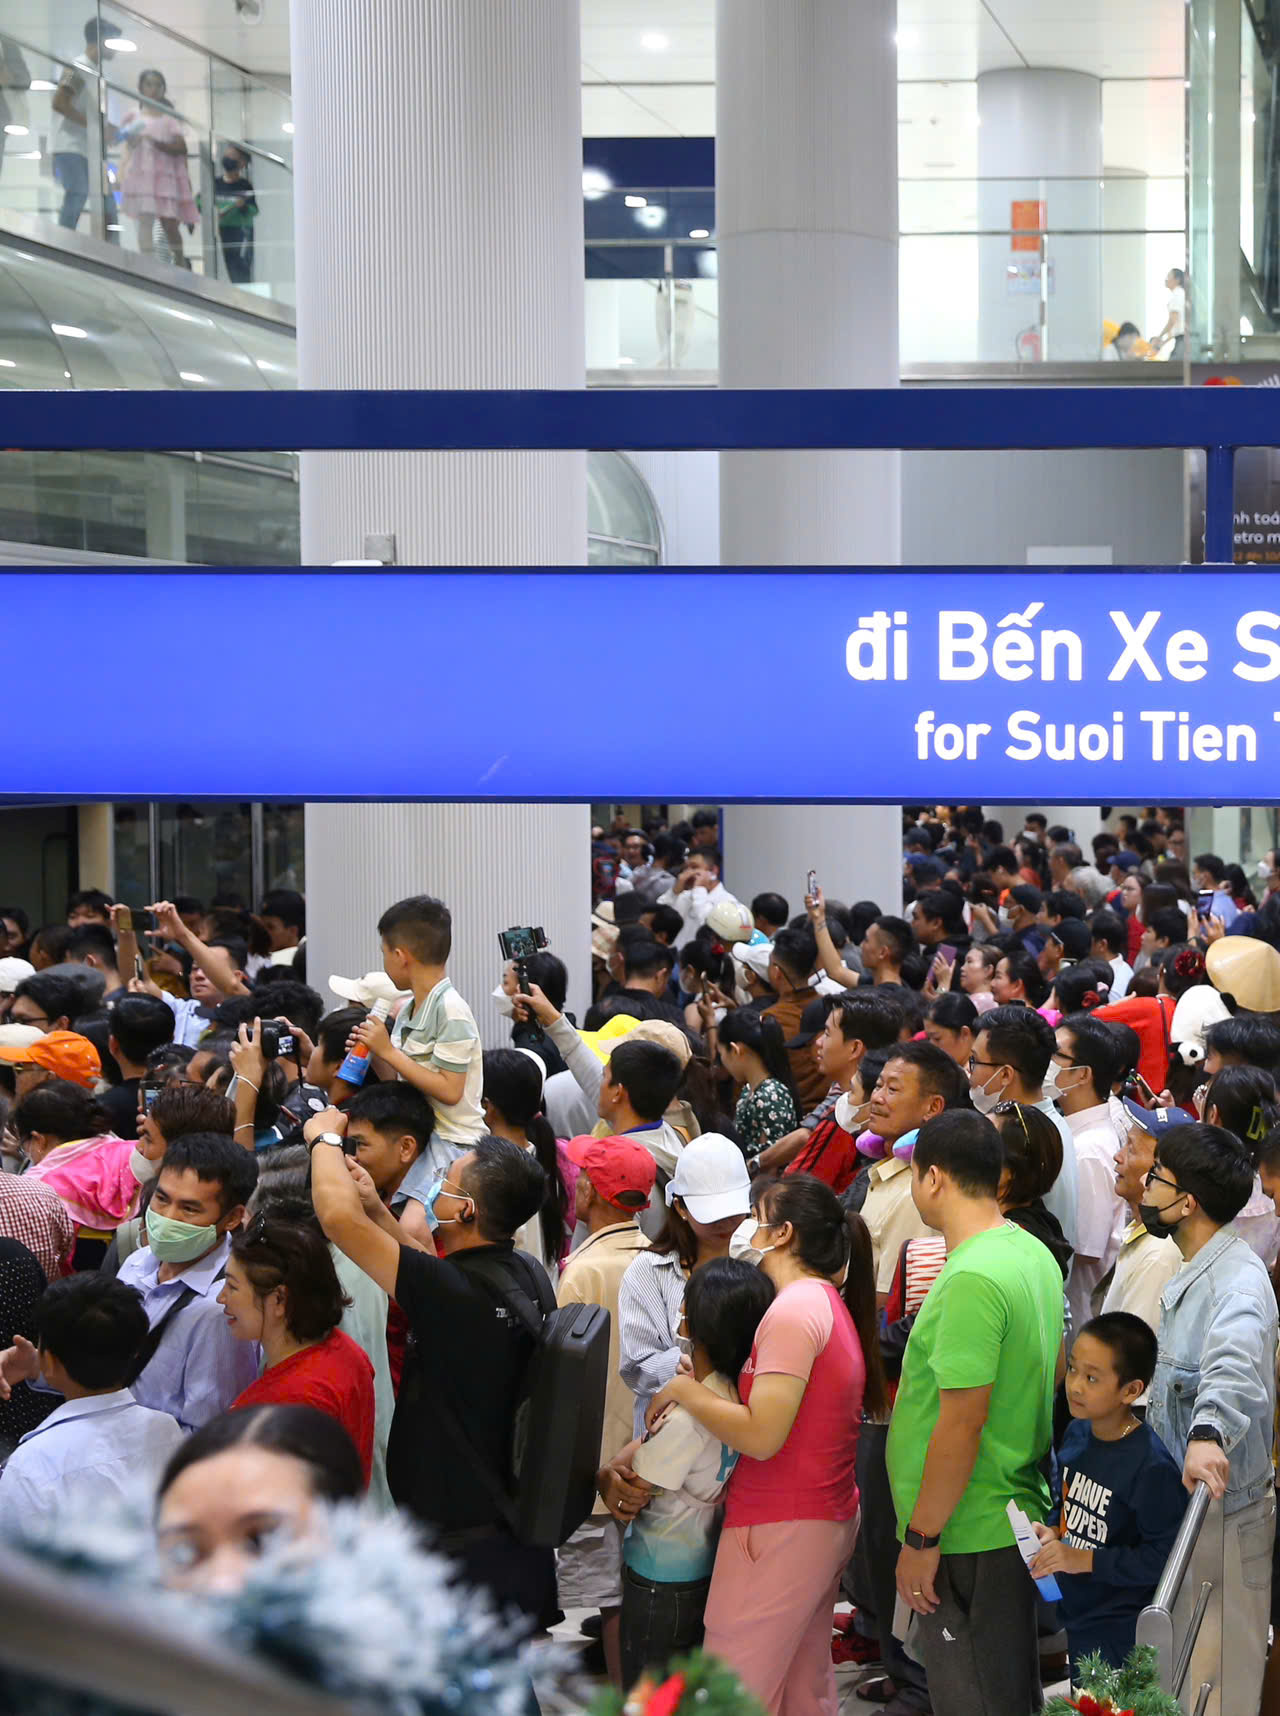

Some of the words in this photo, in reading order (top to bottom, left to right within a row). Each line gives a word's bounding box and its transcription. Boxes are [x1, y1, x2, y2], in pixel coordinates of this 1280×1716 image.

[1234, 531, 1264, 544] etro
[846, 611, 907, 681] đi
[939, 603, 1082, 681] Bến
[1108, 612, 1208, 681] Xe
[915, 711, 991, 761] for
[1006, 711, 1123, 761] Suoi
[1141, 712, 1256, 761] Tien
[1067, 1471, 1112, 1517] HAVE
